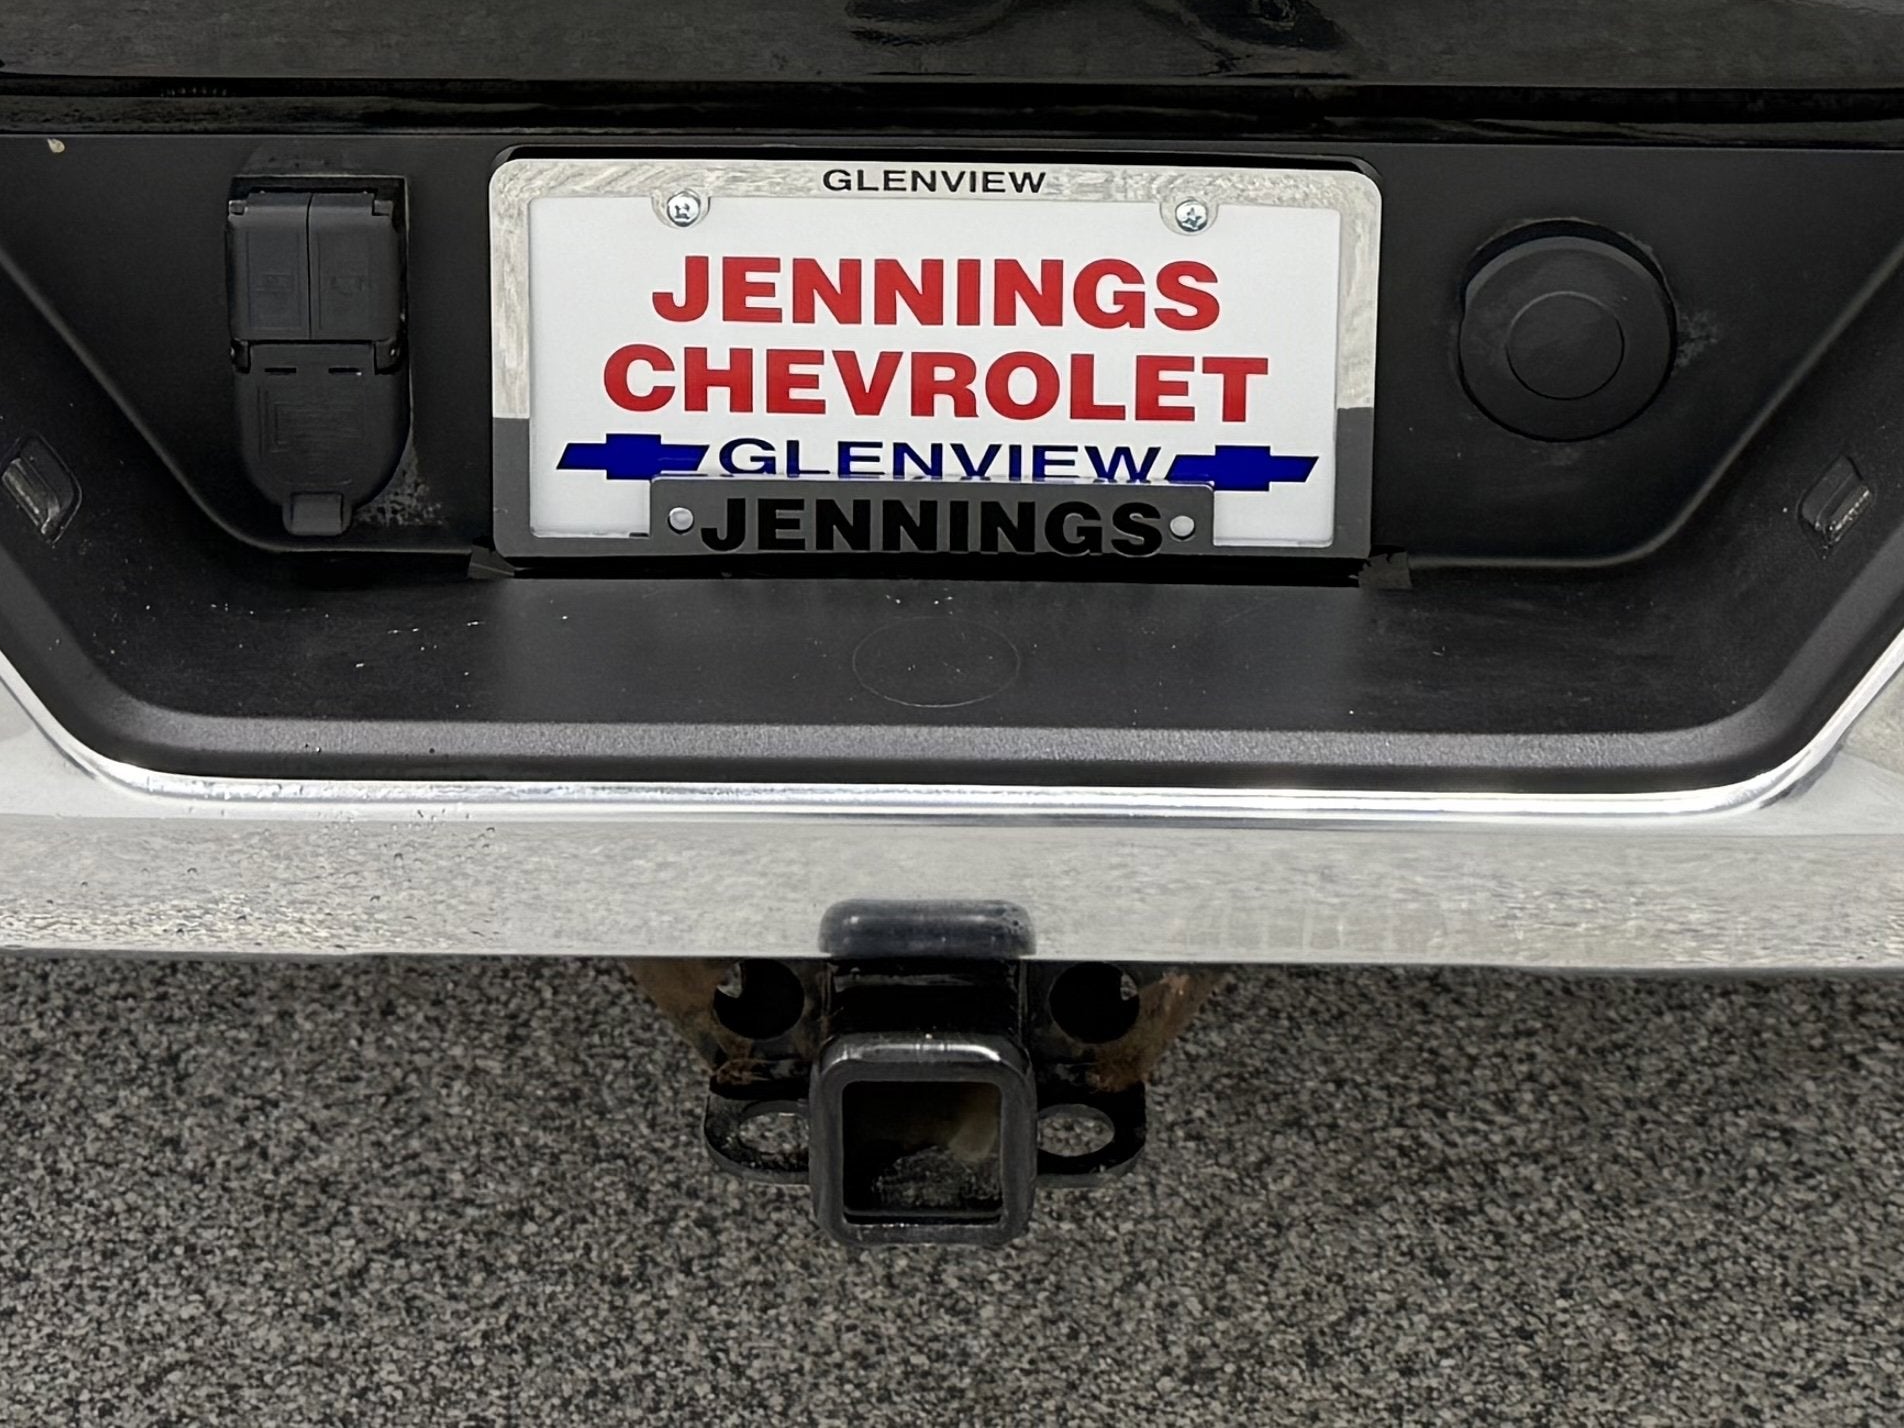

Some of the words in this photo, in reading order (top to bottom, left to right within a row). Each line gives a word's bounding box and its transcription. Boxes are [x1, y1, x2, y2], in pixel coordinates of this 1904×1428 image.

[822, 169, 1047, 194] GLENVIEW
[652, 255, 1221, 331] JENNINGS
[603, 345, 1269, 423] CHEVROLET
[718, 438, 1160, 482] GLENVIEW
[700, 497, 1165, 557] JENNINGS
